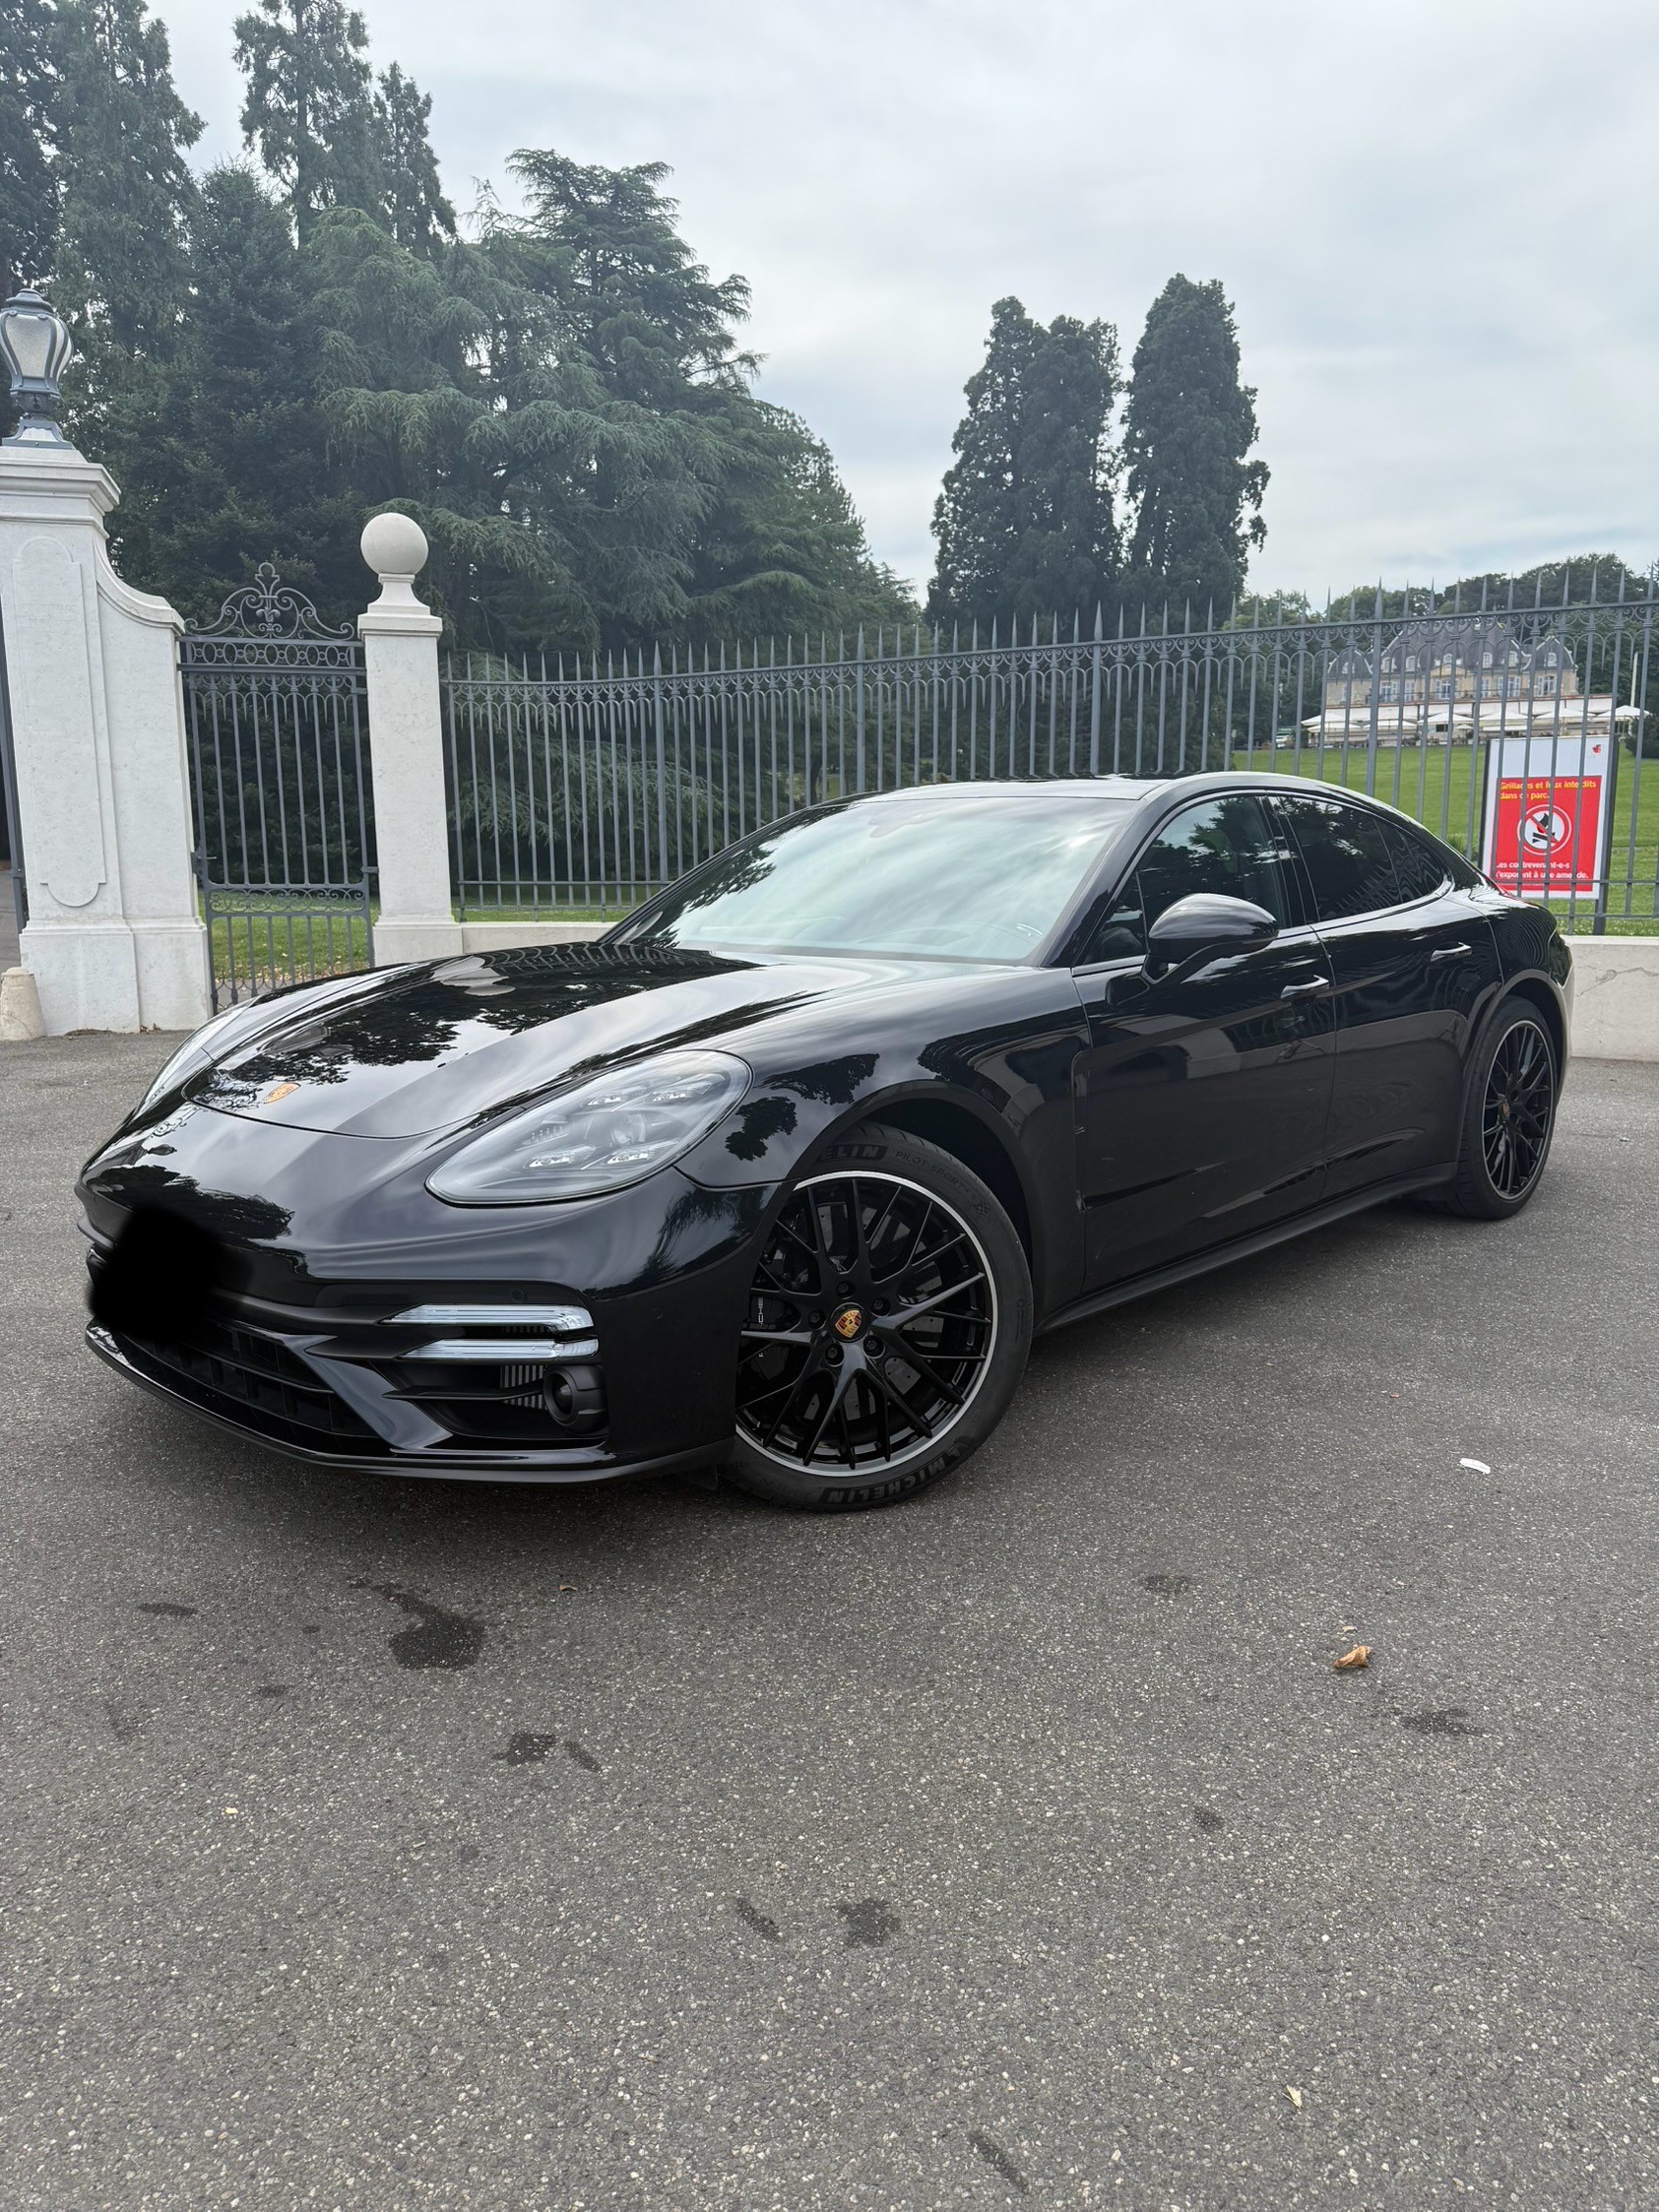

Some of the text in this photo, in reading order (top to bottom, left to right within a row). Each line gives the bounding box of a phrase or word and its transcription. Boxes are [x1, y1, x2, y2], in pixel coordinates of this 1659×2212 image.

[1563, 780, 1597, 789] intedits
[894, 1150, 927, 1167] PILOT
[930, 1164, 966, 1190] SPORT
[826, 1456, 946, 1504] MICHELIN
